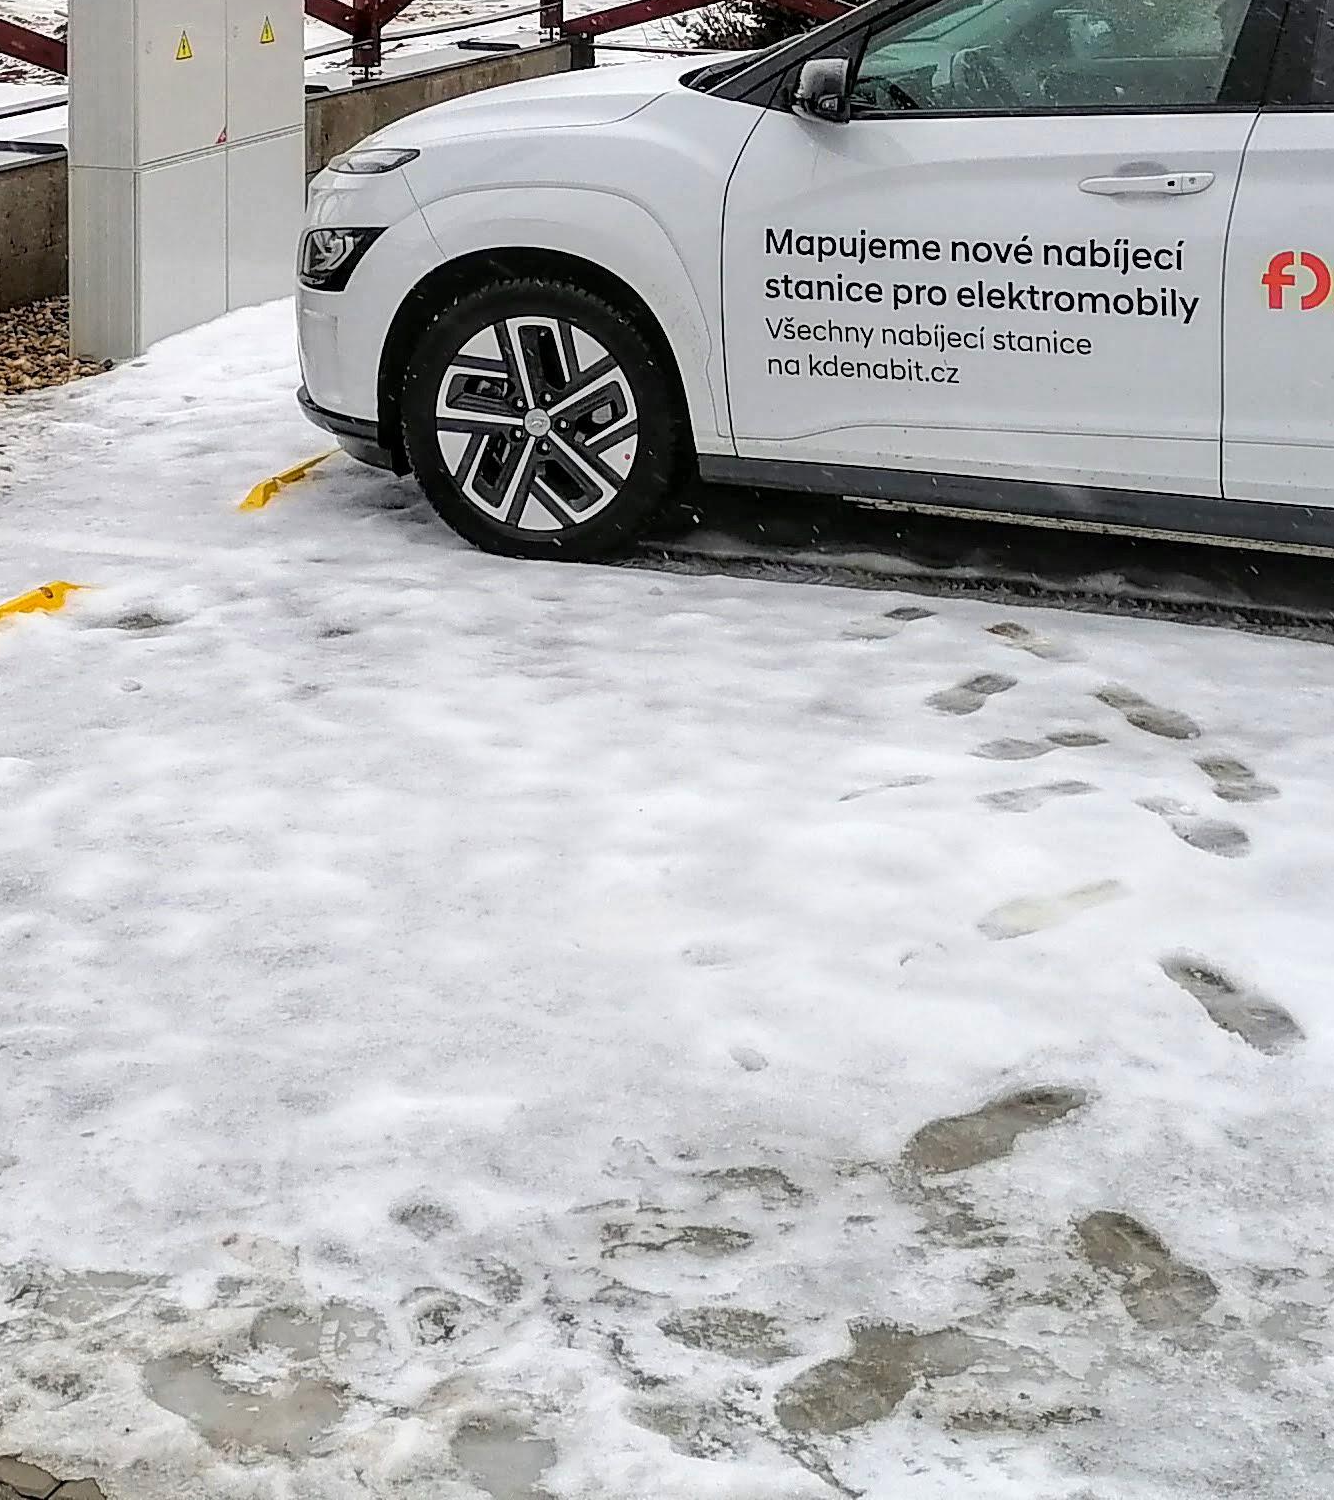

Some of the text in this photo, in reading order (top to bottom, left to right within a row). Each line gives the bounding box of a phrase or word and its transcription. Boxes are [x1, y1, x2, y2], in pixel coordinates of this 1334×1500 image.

[766, 228, 1185, 275] Mapujeme nové nabíjecí
[765, 273, 1200, 324] stanice pro elektromobily
[765, 316, 1092, 355] Všechny nabíjecí stanice
[768, 353, 960, 384] na kdenabit.cz
